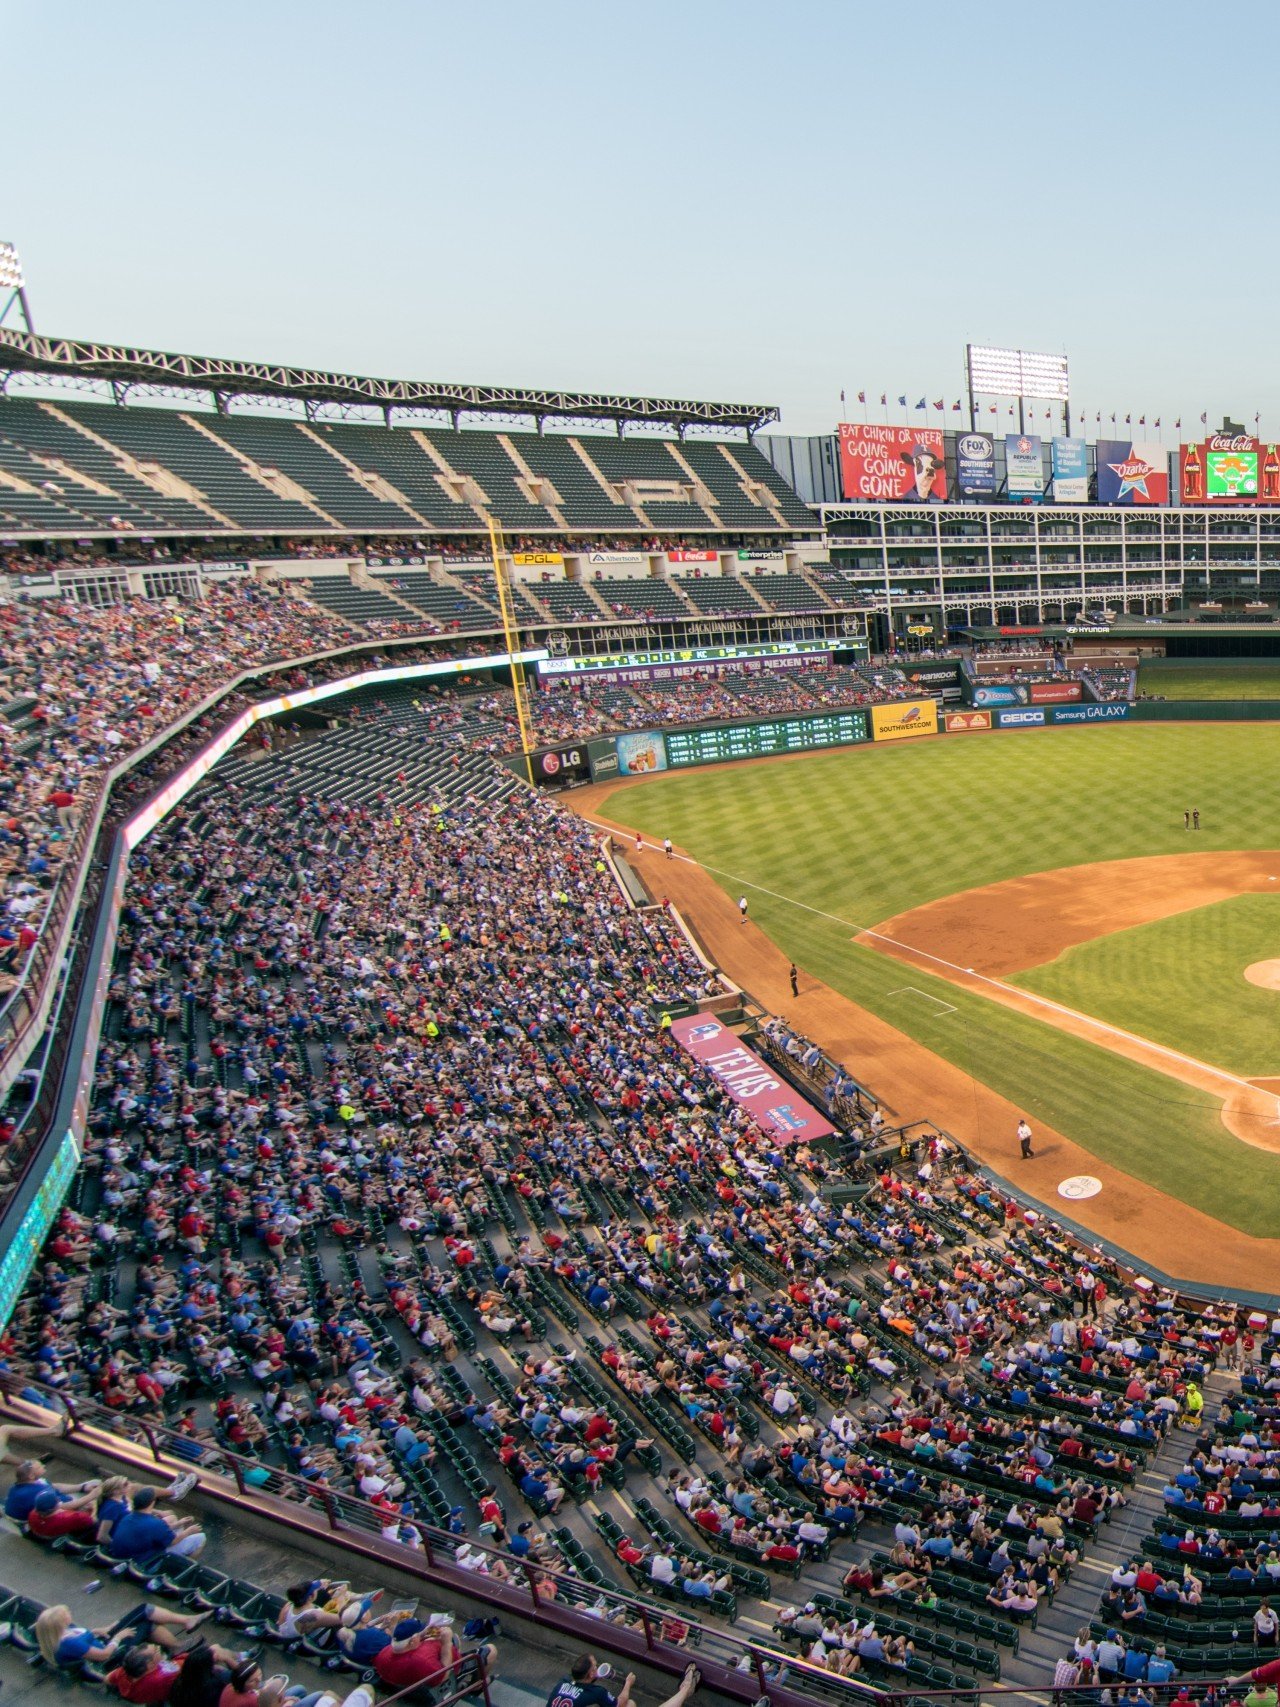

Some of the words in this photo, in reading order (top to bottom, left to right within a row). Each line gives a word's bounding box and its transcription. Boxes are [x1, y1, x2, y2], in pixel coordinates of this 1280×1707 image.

[841, 425, 860, 438] EAT
[862, 426, 894, 443] CHIKIN
[898, 428, 912, 444] OR
[914, 431, 942, 446] WEER
[848, 441, 888, 458] GOING
[966, 440, 984, 450] FOX
[864, 458, 906, 477] GOING
[1118, 463, 1149, 478] Ozarka
[860, 476, 903, 497] GONE
[524, 554, 554, 564] PGL
[688, 622, 710, 633] JACK
[712, 620, 743, 632] DANIEL'S
[772, 619, 790, 628] JACK
[792, 617, 820, 628] DANIEL'S
[596, 628, 619, 638] JACK
[622, 626, 657, 638] DANIEL'S
[764, 656, 800, 668] NEXEN
[673, 664, 714, 676] NEXEN
[919, 671, 957, 680] HANKOOK
[572, 672, 618, 685] NEXEN
[620, 670, 650, 680] TIRE
[1000, 712, 1044, 723] GEICO
[1056, 711, 1086, 722] Samsung
[1088, 706, 1127, 717] GALAXY
[880, 720, 932, 733] SOUTHWEST.COM
[562, 750, 580, 768] LG
[706, 1047, 780, 1098] TEXAS
[558, 1682, 584, 1698] YOUNG
